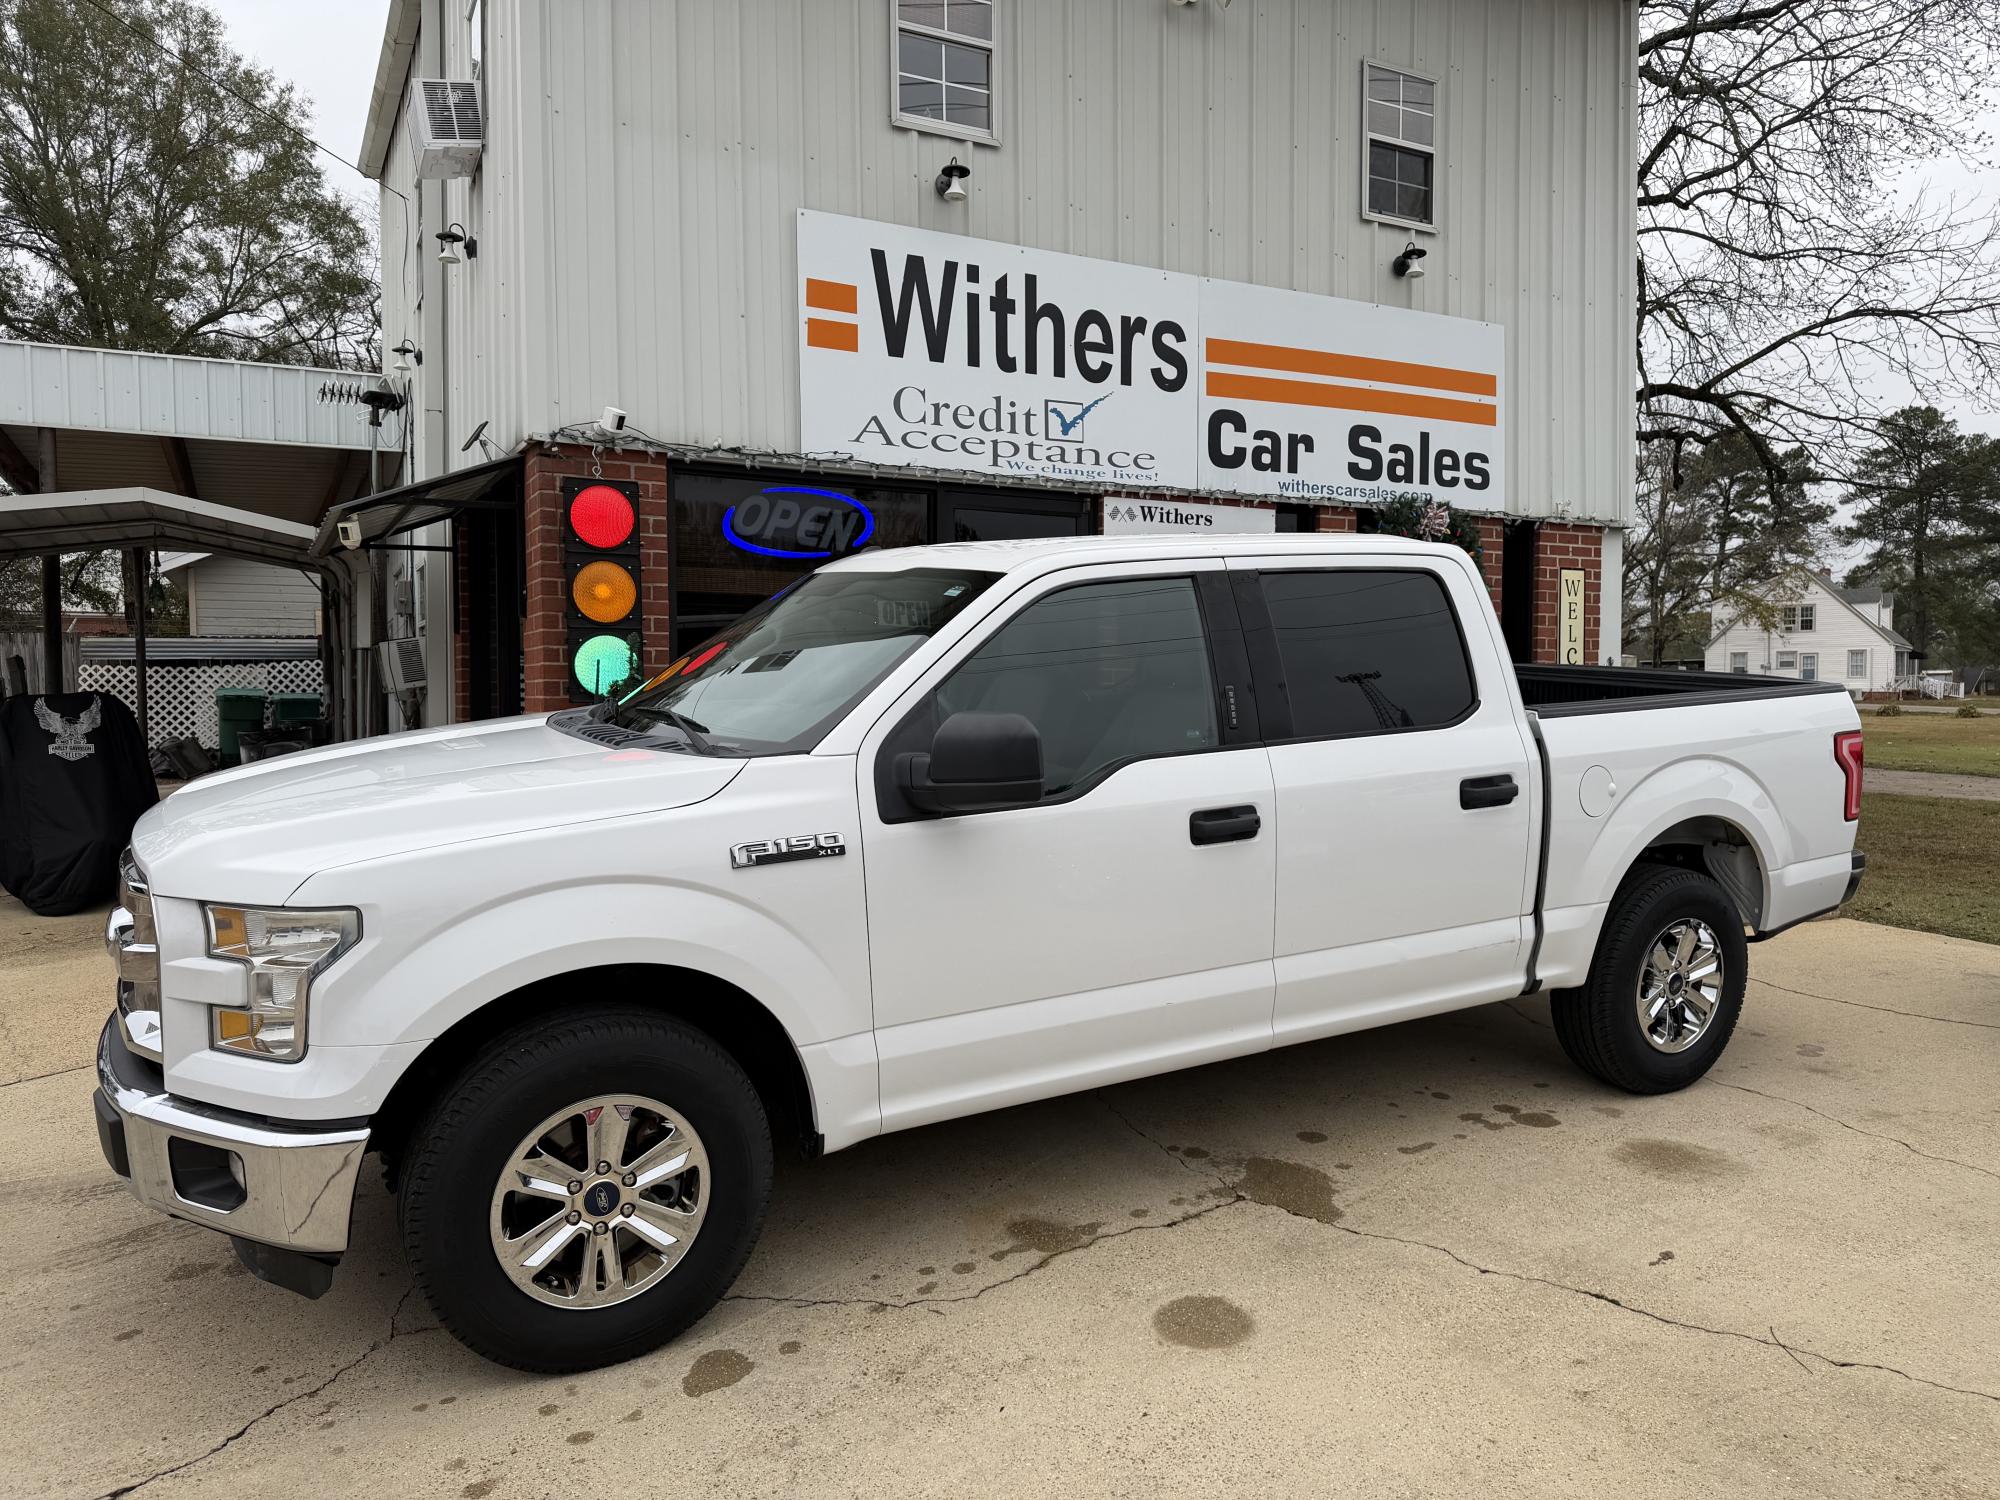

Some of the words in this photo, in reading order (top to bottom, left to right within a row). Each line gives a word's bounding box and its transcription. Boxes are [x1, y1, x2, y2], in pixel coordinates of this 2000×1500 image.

[870, 248, 1188, 393] Withers
[893, 386, 1040, 437] Credit
[848, 415, 1157, 471] Acceptance
[1207, 408, 1315, 475] Car
[1347, 424, 1491, 491] Sales
[1006, 460, 1035, 472] We
[1041, 464, 1106, 480] change
[1112, 470, 1159, 482] lives!
[1278, 479, 1432, 502] witherscarsalescom
[733, 494, 860, 553] OPEN
[1139, 505, 1213, 527] Withers
[818, 847, 841, 856] XLT
